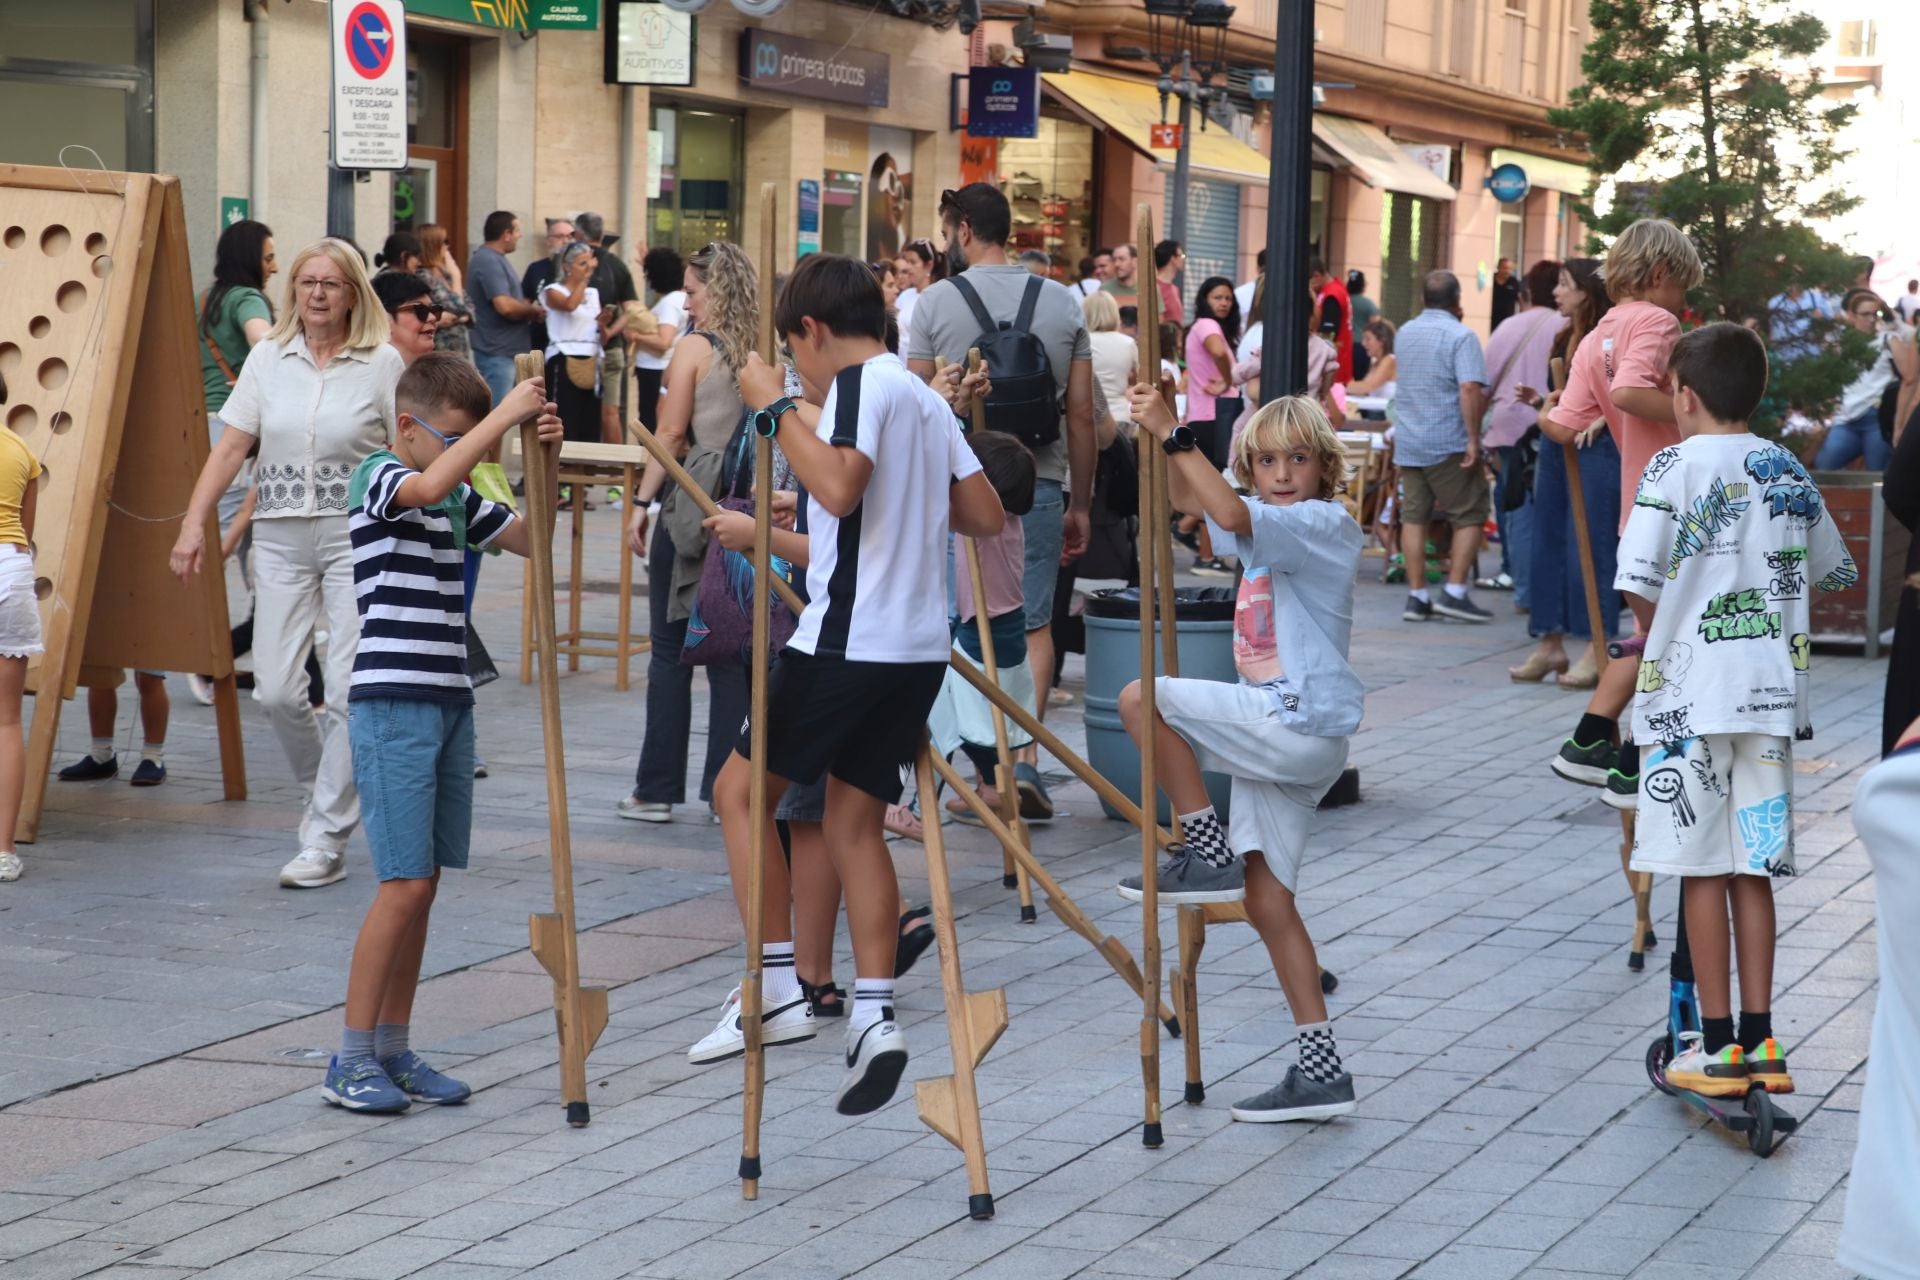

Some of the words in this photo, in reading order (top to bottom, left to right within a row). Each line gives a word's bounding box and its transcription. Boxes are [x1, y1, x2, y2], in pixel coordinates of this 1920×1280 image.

[623, 58, 685, 70] AUDITIVOS
[781, 52, 825, 79] primera
[342, 86, 374, 96] EXCEPTO
[375, 87, 400, 96] CARGA
[355, 99, 393, 108] DESCARGA
